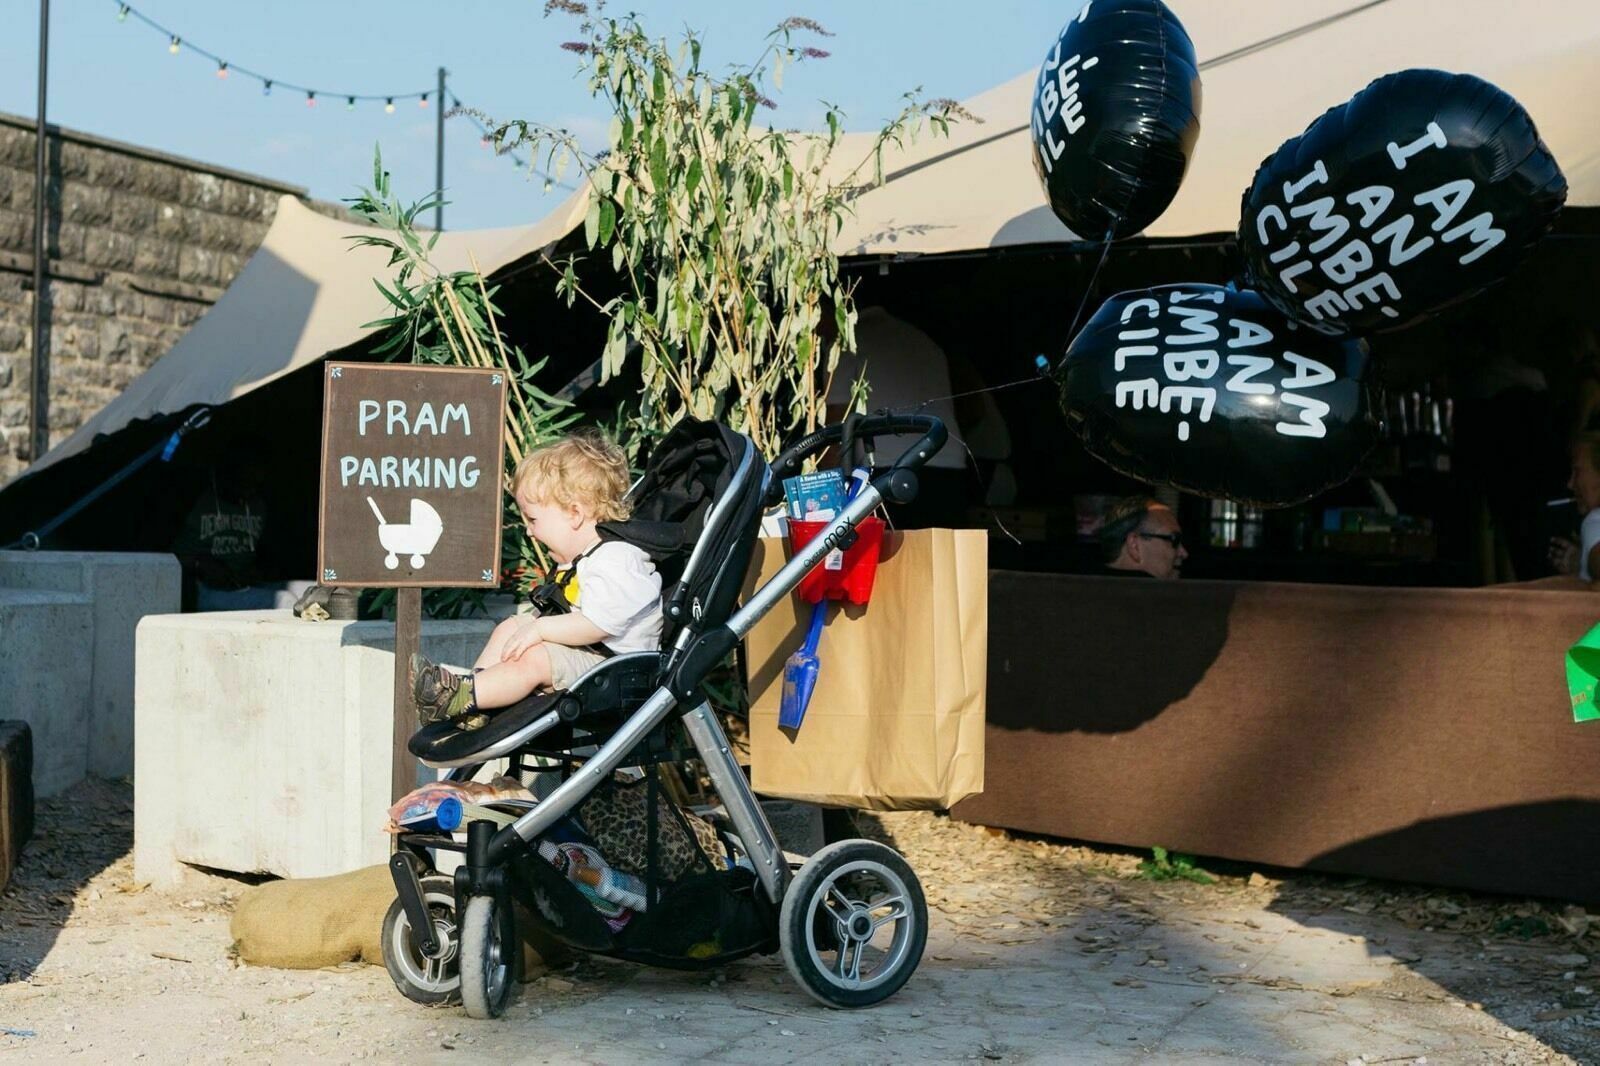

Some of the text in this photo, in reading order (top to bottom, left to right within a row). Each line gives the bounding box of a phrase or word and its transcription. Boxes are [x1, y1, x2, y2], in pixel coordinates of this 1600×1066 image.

[1040, 93, 1086, 195] ILE
[1346, 185, 1435, 266] AN
[1387, 121, 1506, 265] I AM
[1257, 204, 1349, 320] CILE
[1114, 298, 1160, 410] CILE
[1225, 318, 1276, 394] AN
[1275, 351, 1336, 438] AM
[358, 400, 471, 436] PRAM
[340, 455, 481, 489] PARKING
[824, 516, 855, 550] max
